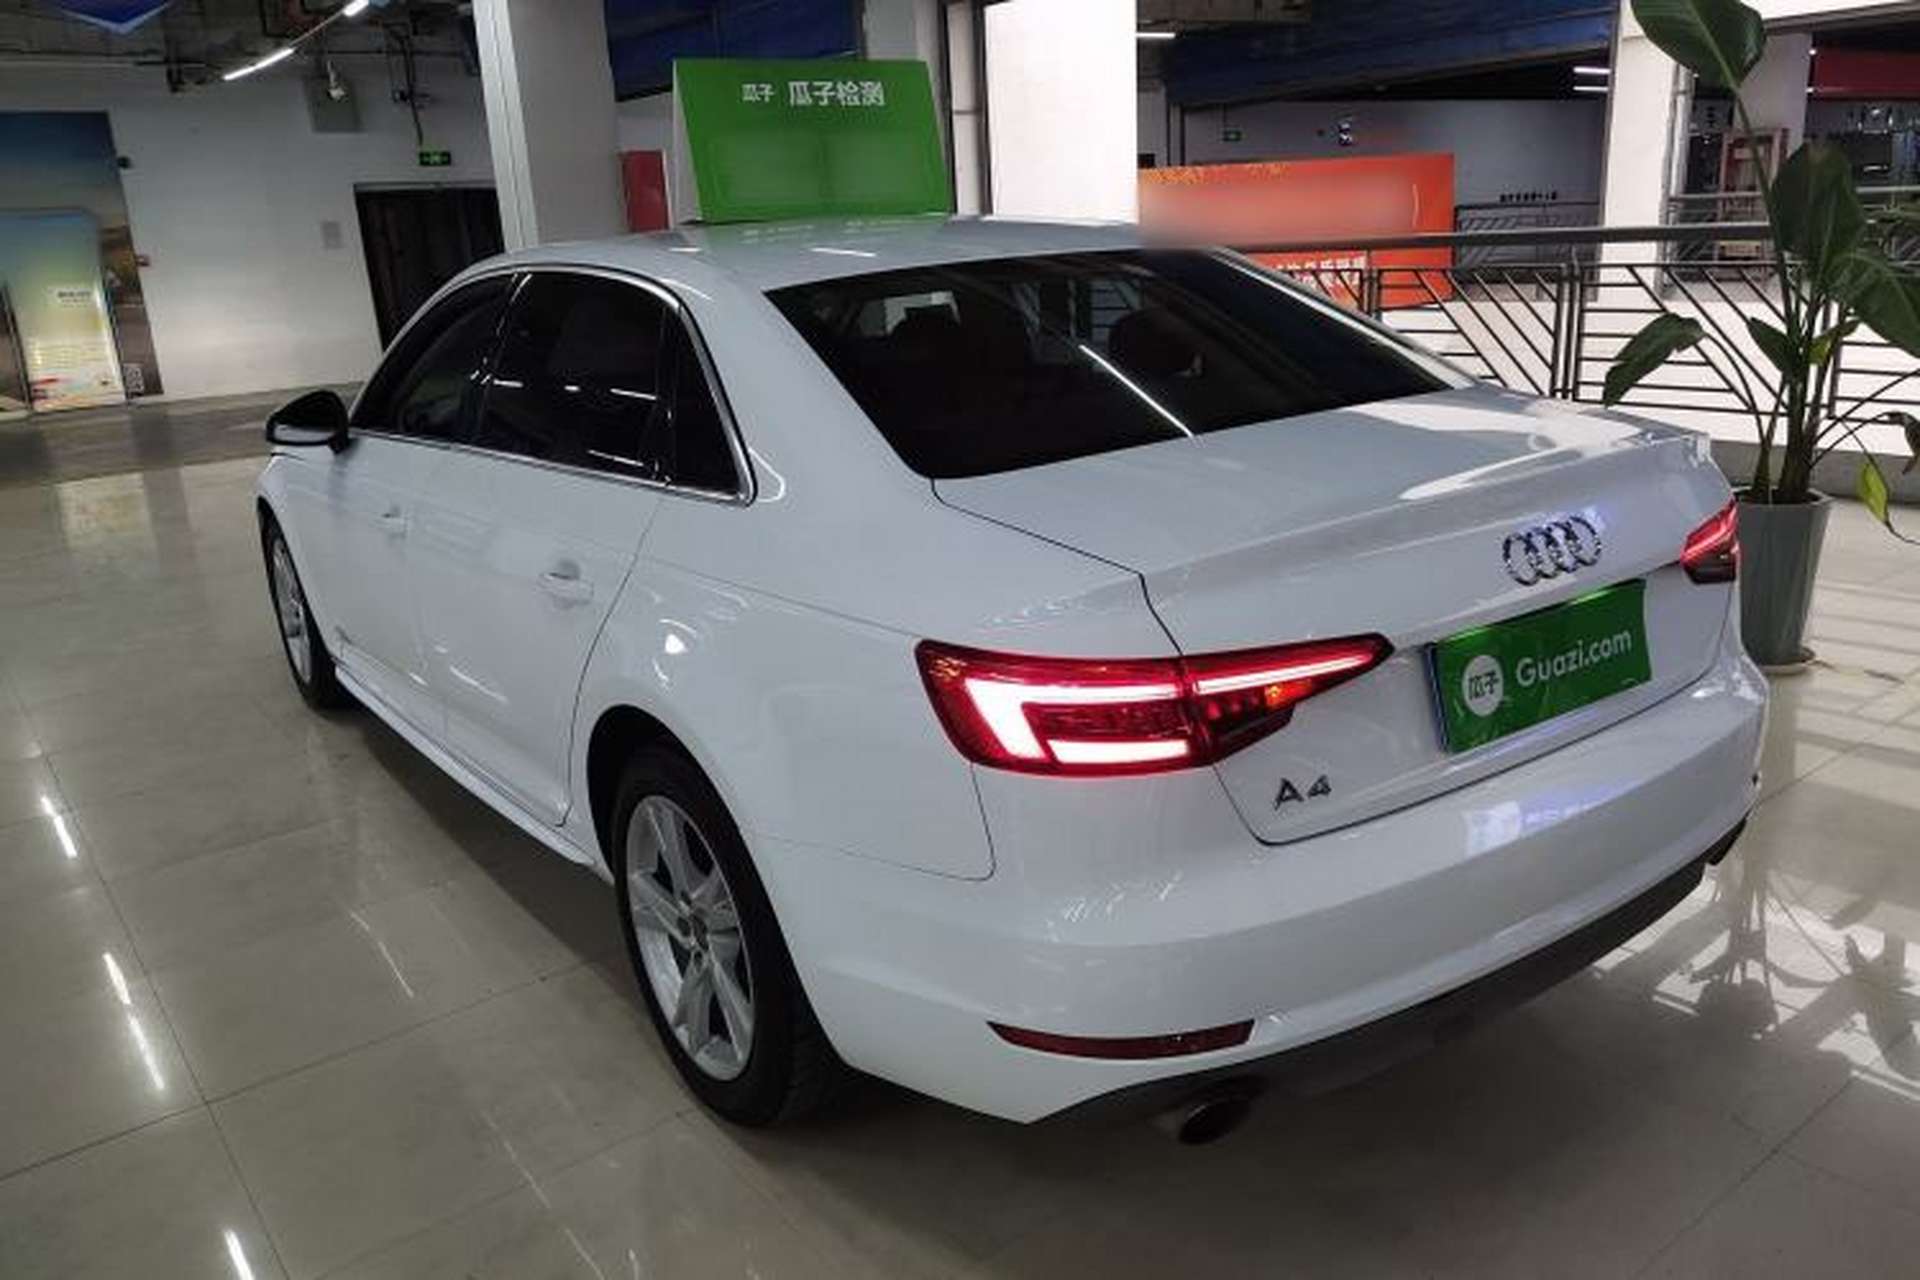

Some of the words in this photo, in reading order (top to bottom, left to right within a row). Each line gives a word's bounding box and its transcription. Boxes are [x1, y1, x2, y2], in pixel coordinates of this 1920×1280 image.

[788, 81, 885, 106] 瓜子检测
[1516, 630, 1632, 687] Guazi.com
[1273, 775, 1332, 811] A4
